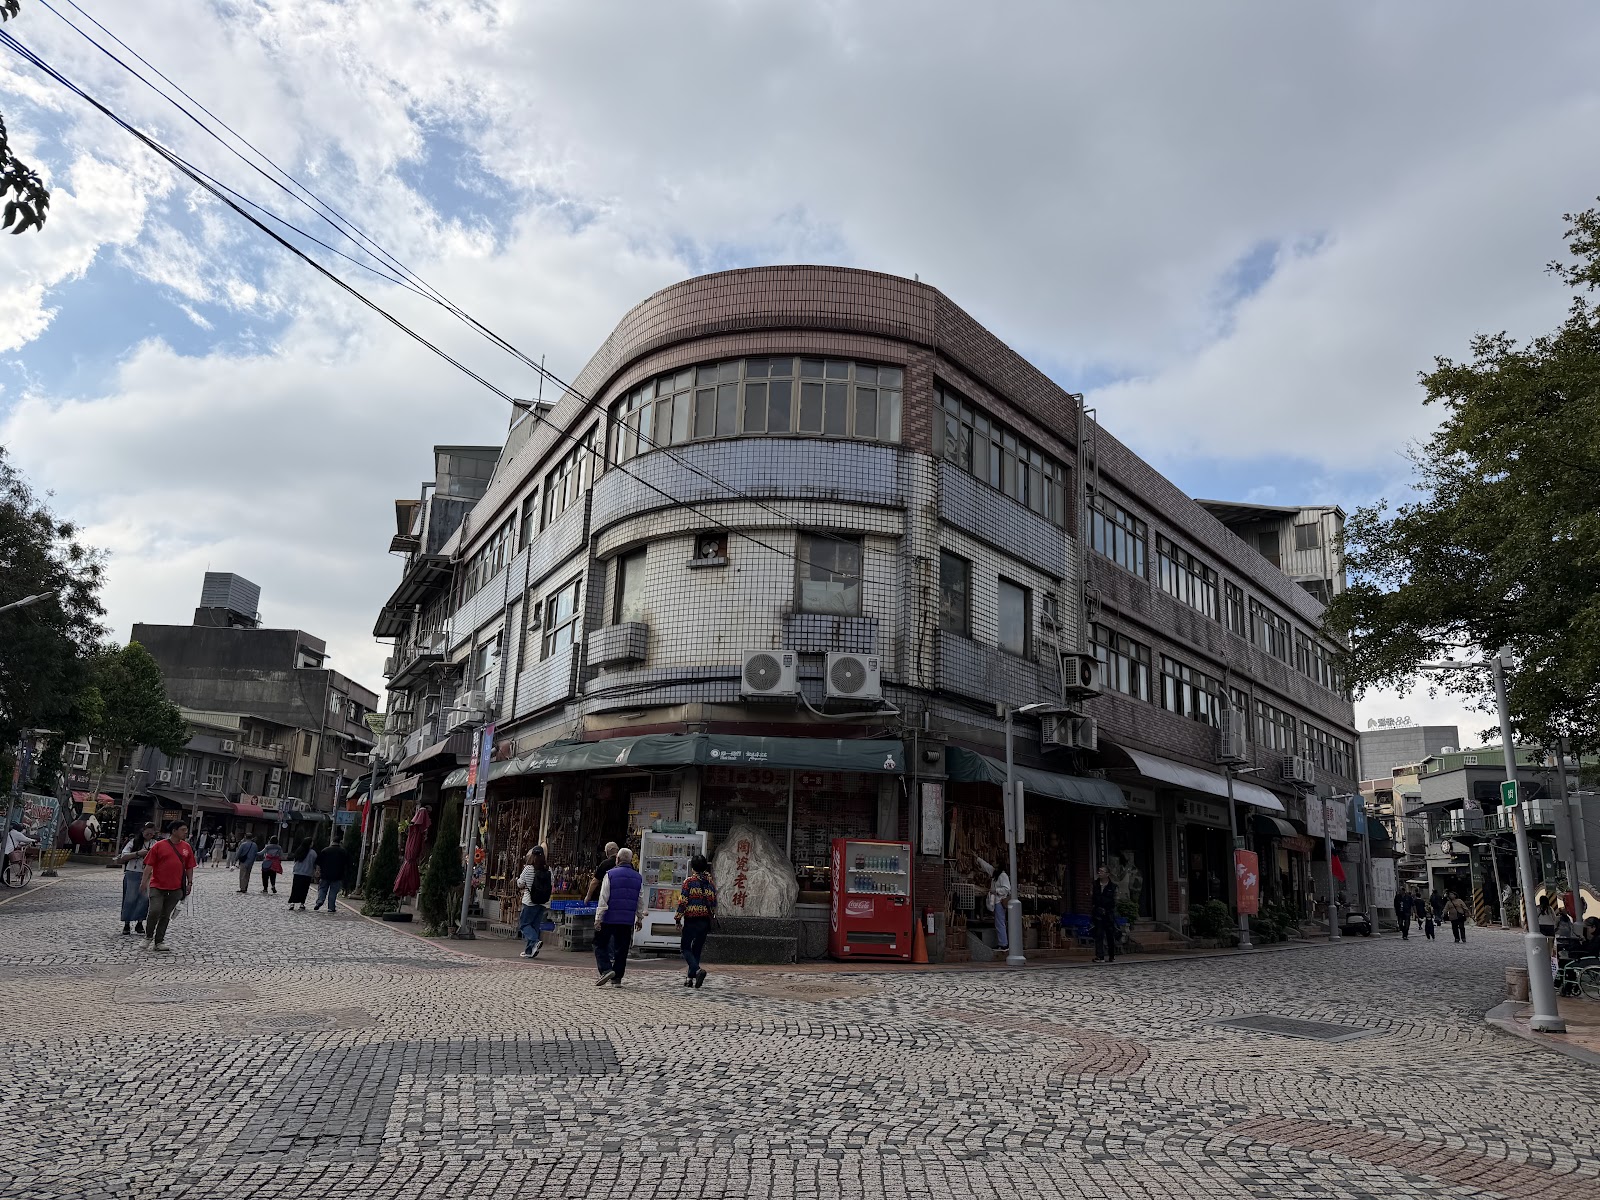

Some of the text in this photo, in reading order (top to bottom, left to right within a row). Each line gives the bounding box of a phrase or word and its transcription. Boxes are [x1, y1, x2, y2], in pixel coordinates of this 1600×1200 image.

[732, 839, 752, 908] 陶瓷老街
[847, 899, 870, 909] Coca-Cola
